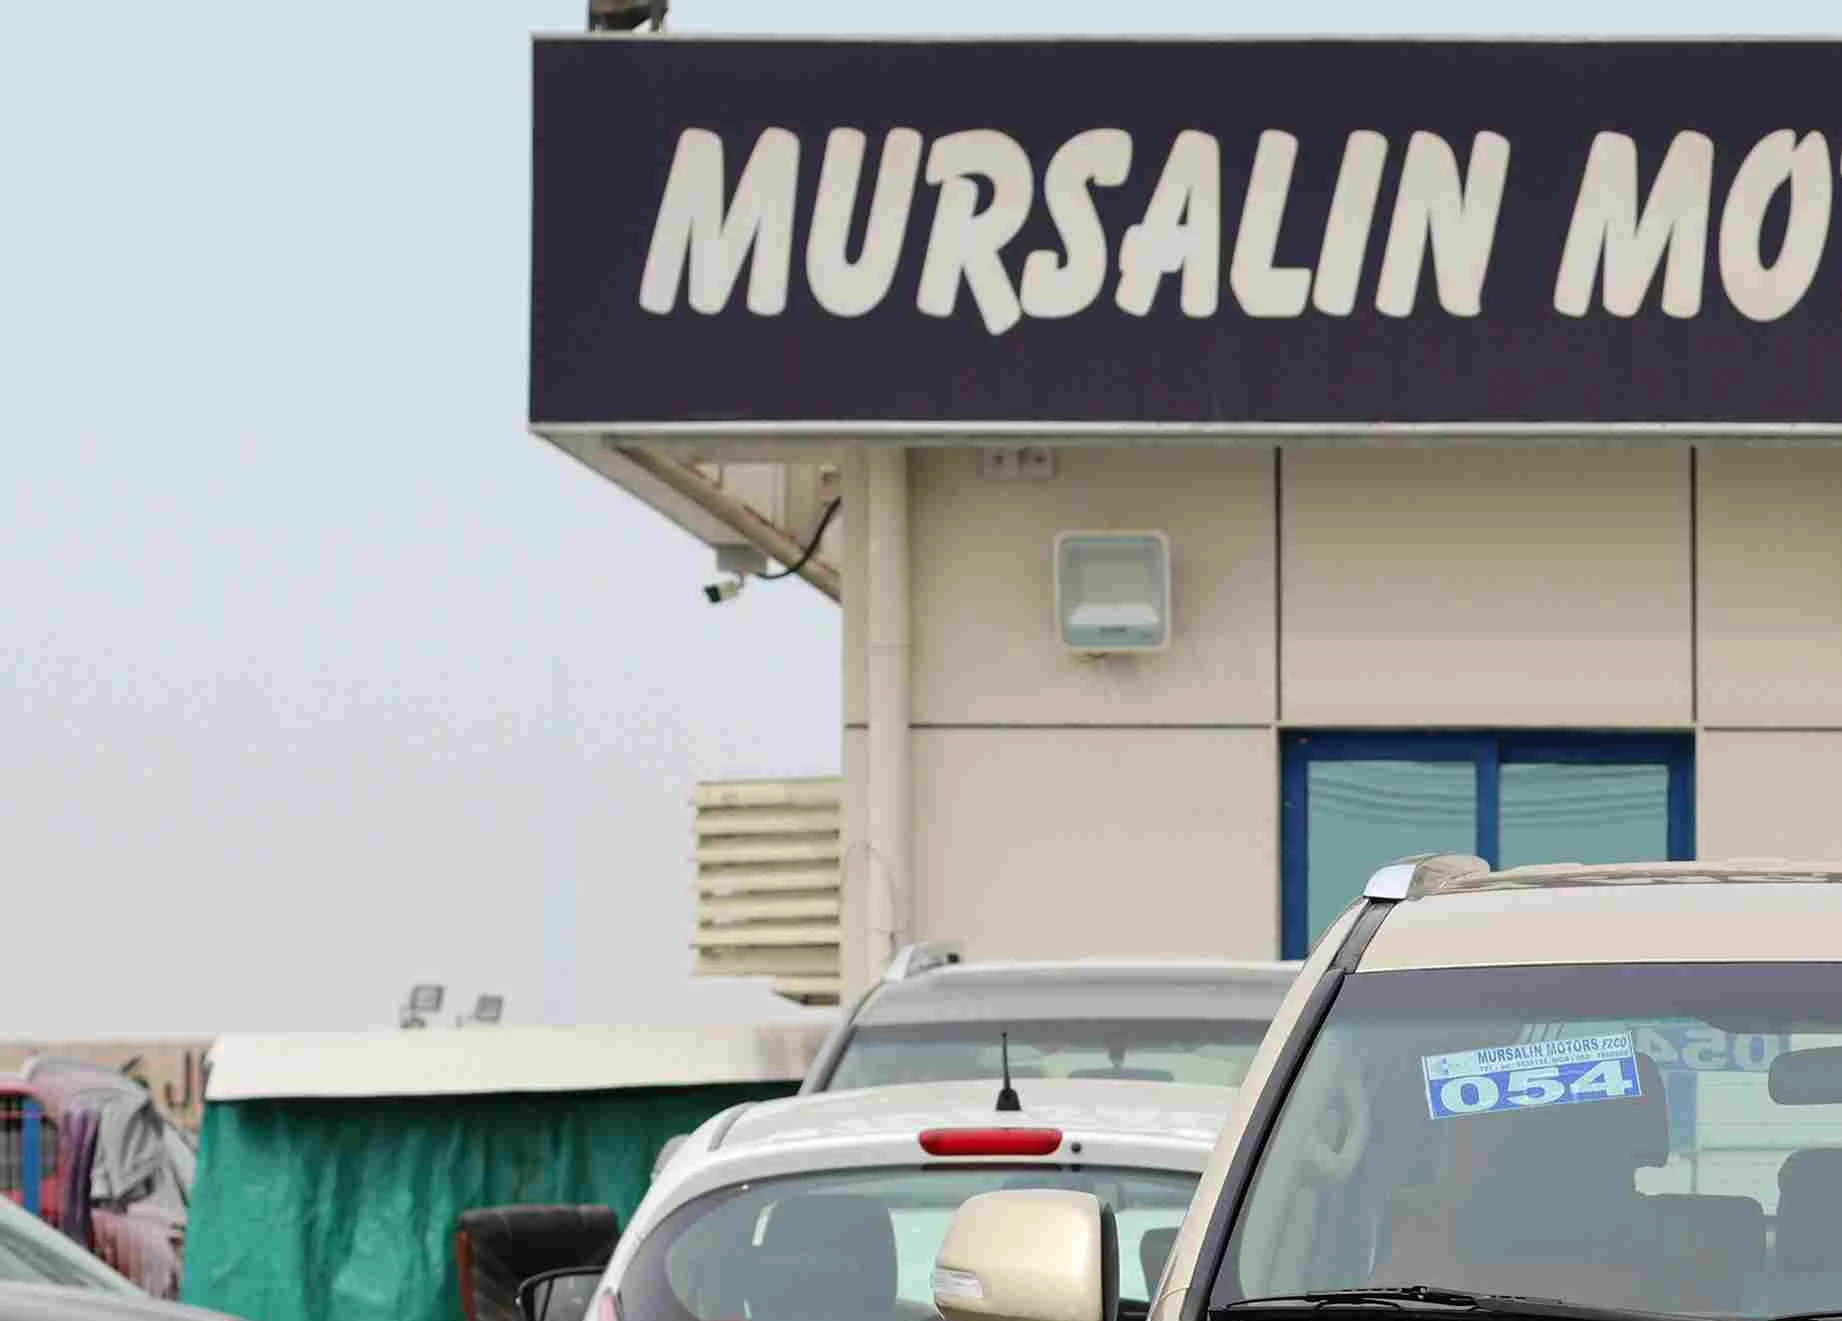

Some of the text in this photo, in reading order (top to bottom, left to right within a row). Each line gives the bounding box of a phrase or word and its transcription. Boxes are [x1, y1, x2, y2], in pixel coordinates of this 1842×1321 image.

[639, 127, 1511, 335] MURSALIN
[1477, 1044, 1544, 1066] MURSALIN
[1546, 1038, 1599, 1056] MOTORS
[1439, 1059, 1633, 1114] 054
